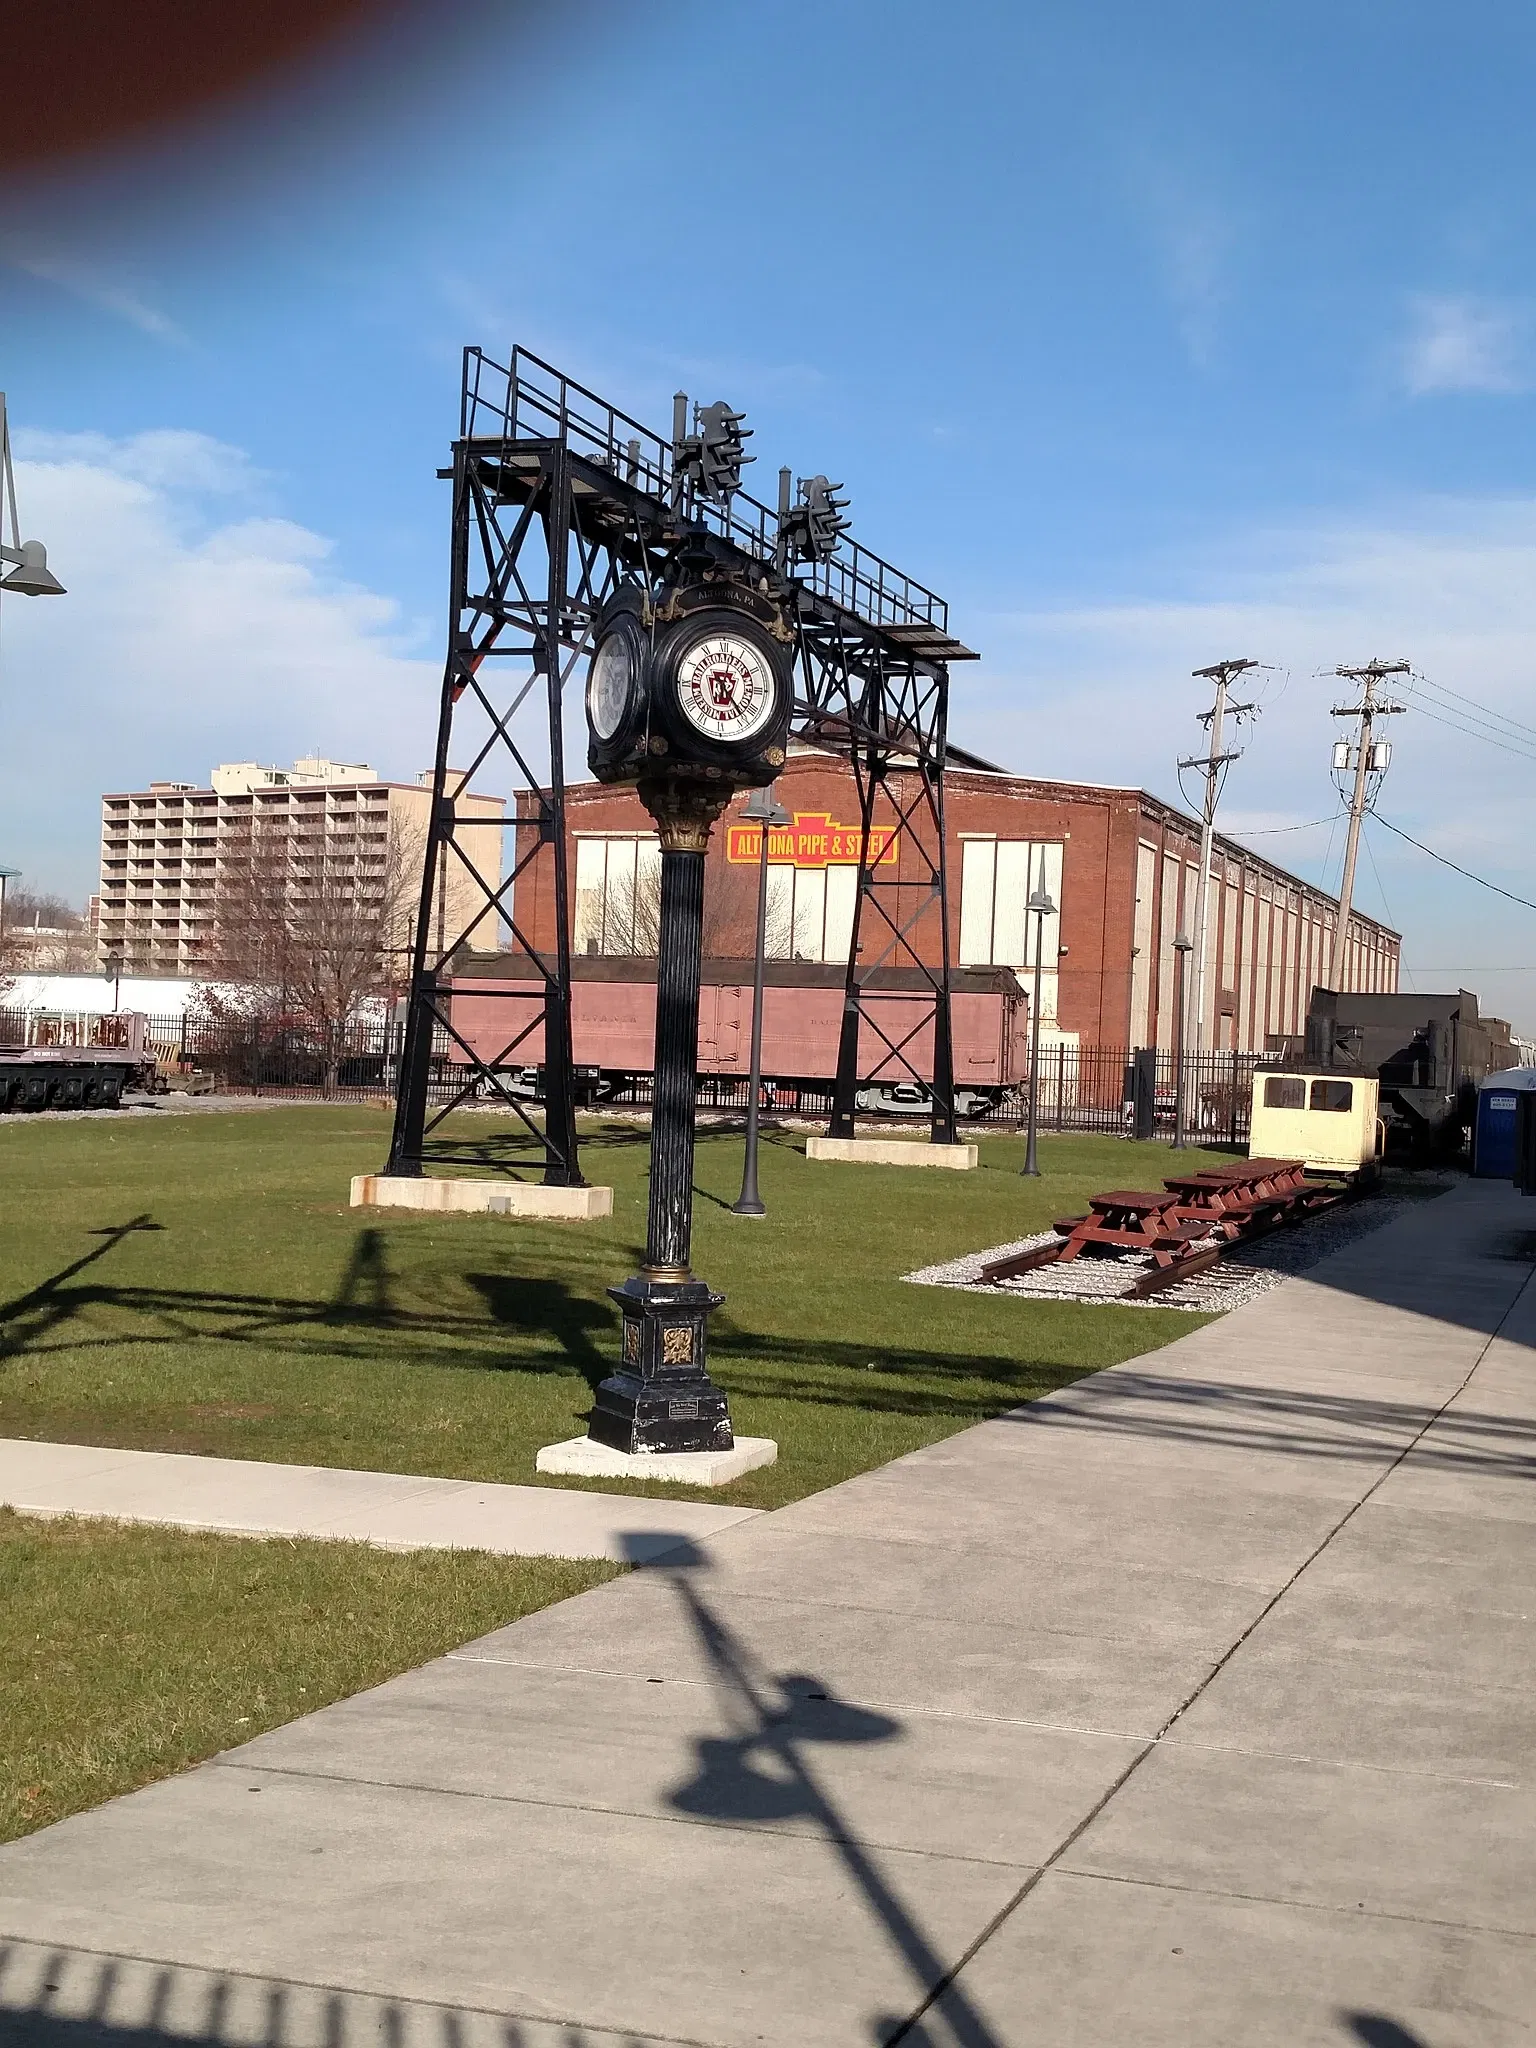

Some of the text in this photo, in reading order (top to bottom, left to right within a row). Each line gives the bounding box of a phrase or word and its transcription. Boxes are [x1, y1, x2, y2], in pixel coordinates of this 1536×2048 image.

[744, 595, 754, 607] PA
[718, 642, 729, 653] XII
[692, 653, 748, 684] RAILROADERS
[737, 834, 885, 856] ALTONA PIPE & STEL
